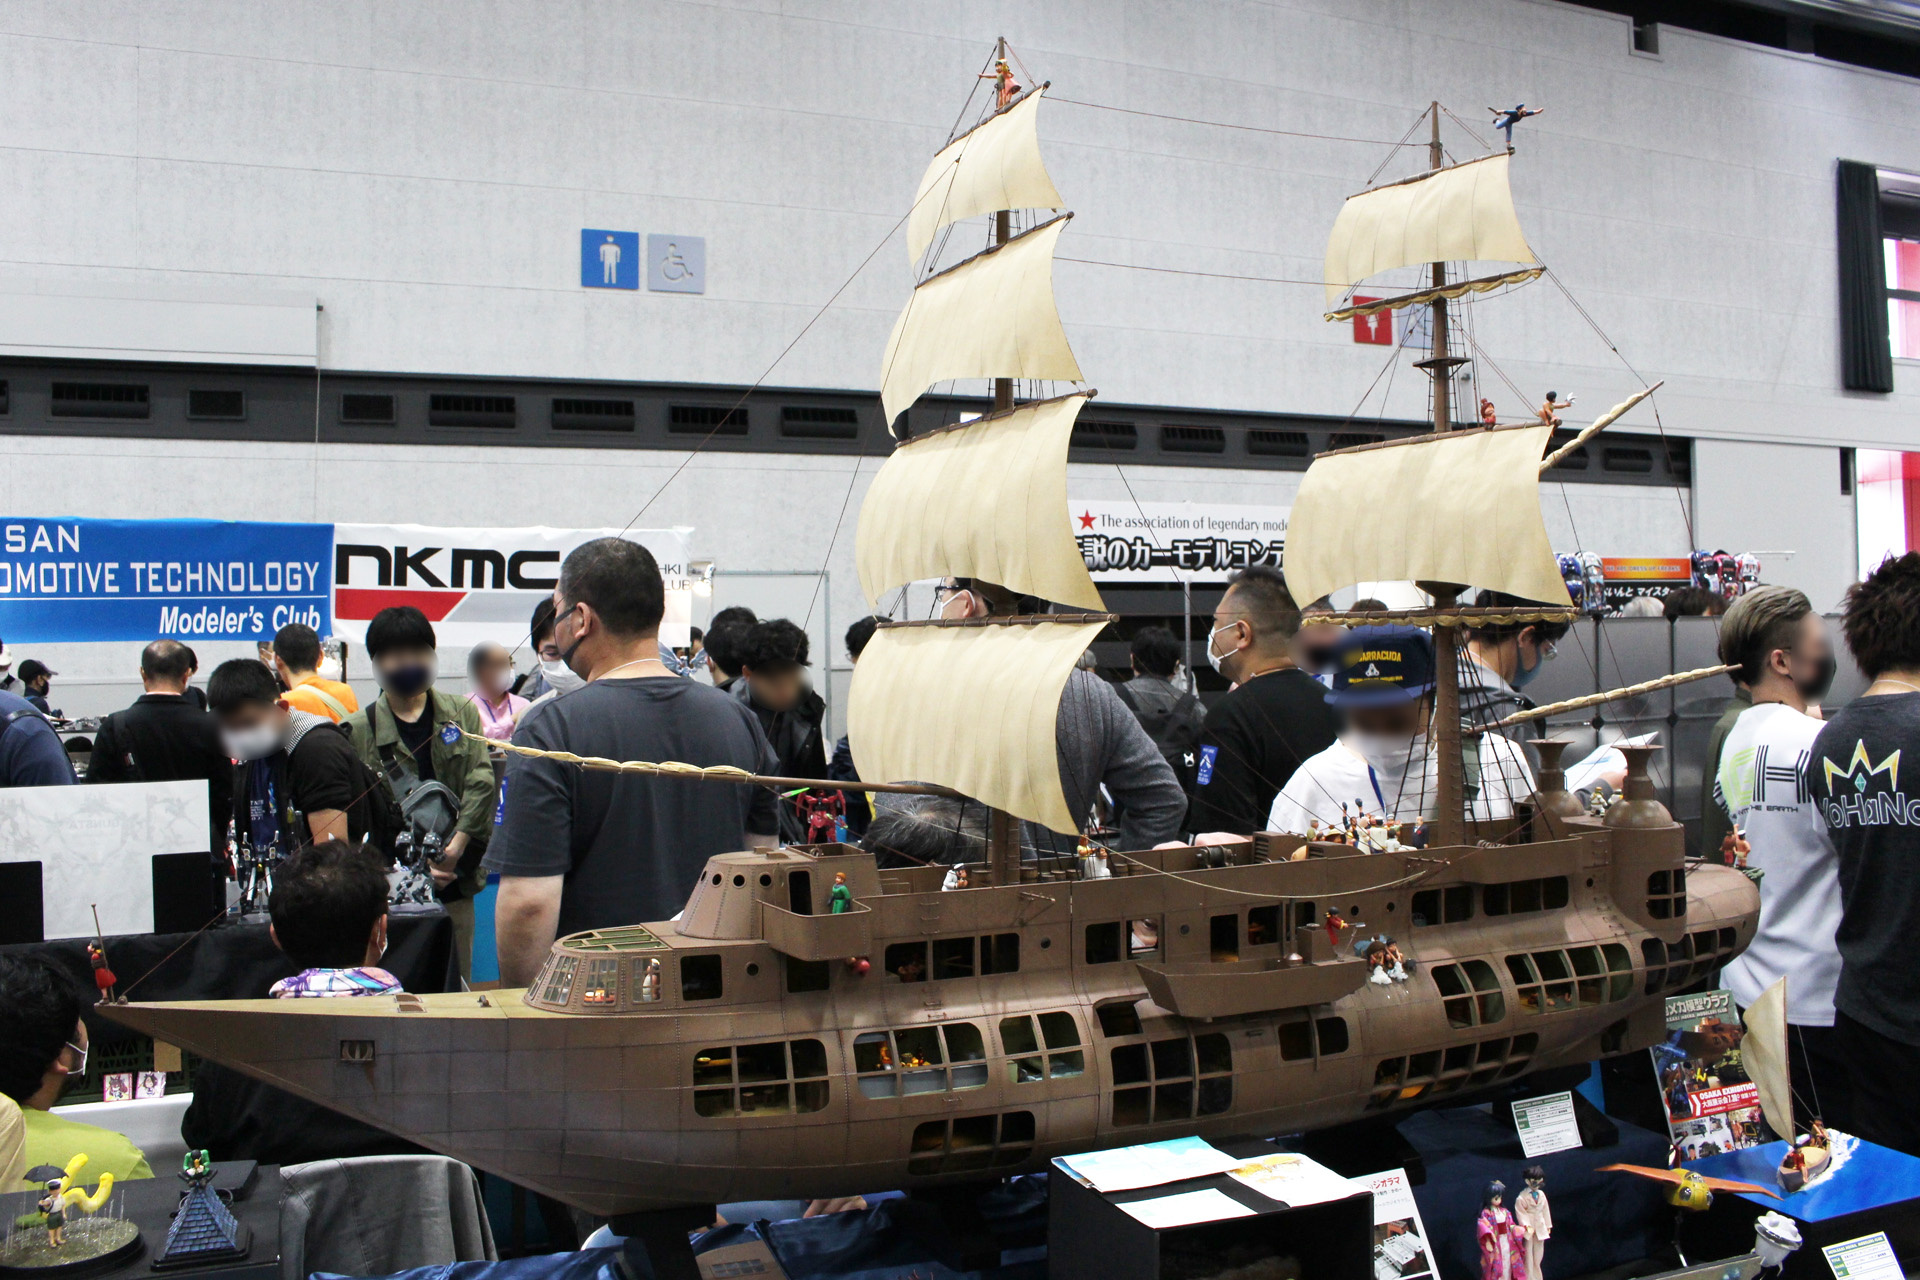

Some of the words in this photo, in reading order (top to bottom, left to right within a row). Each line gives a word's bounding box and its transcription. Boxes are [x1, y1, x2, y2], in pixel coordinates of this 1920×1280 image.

[1100, 514, 1122, 528] The
[1125, 515, 1190, 529] association
[1193, 516, 1204, 529] of
[1208, 516, 1260, 533] legendary
[6, 525, 80, 552] SAN
[130, 562, 319, 593] TECHNOLOGY
[1356, 651, 1401, 662] ARRACUDA
